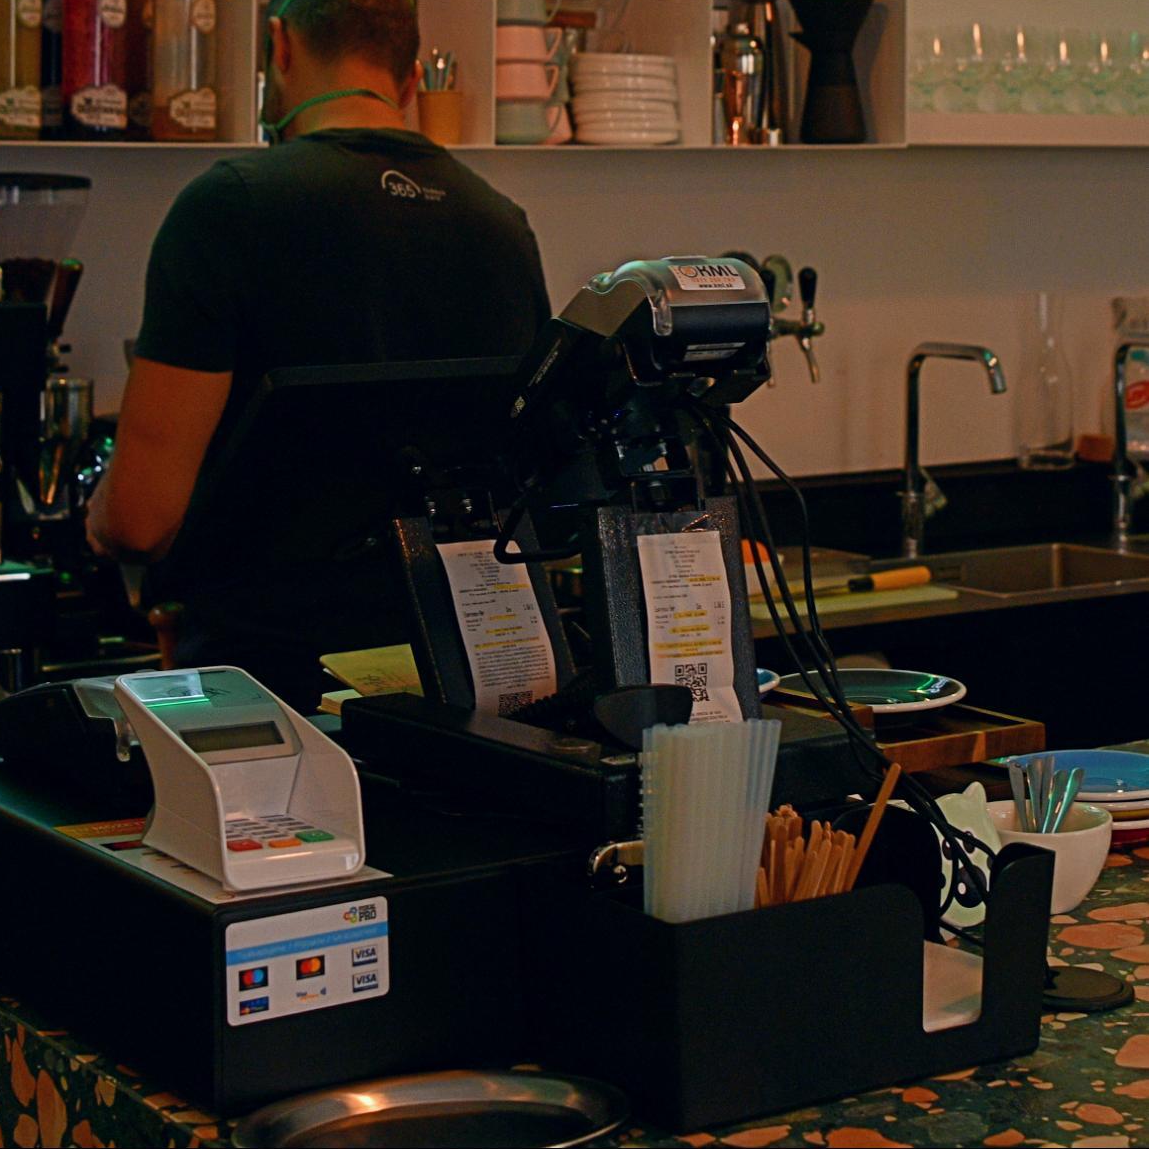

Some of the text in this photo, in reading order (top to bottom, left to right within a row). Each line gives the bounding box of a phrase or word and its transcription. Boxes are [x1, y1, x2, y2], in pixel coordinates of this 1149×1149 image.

[388, 181, 417, 199] 365
[695, 265, 739, 277] KML
[355, 948, 376, 959] VISA
[355, 973, 377, 985] VISA
